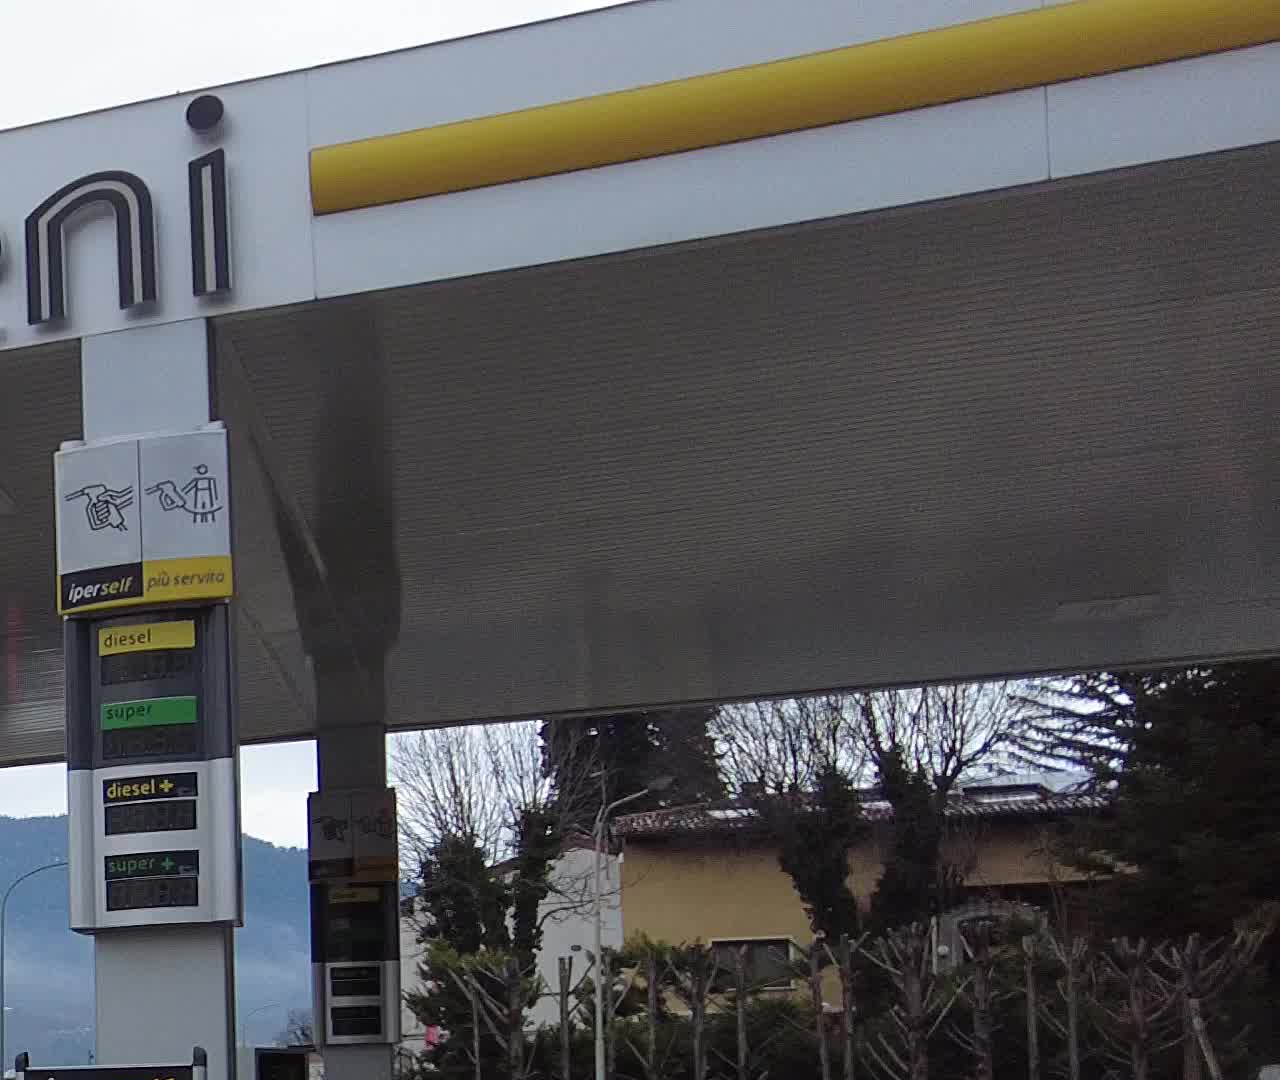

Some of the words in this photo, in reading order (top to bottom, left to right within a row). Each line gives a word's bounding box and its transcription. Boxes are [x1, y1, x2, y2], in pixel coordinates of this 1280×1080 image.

[68, 576, 134, 603] iperself
[104, 629, 151, 647] diesel
[106, 702, 153, 721] super
